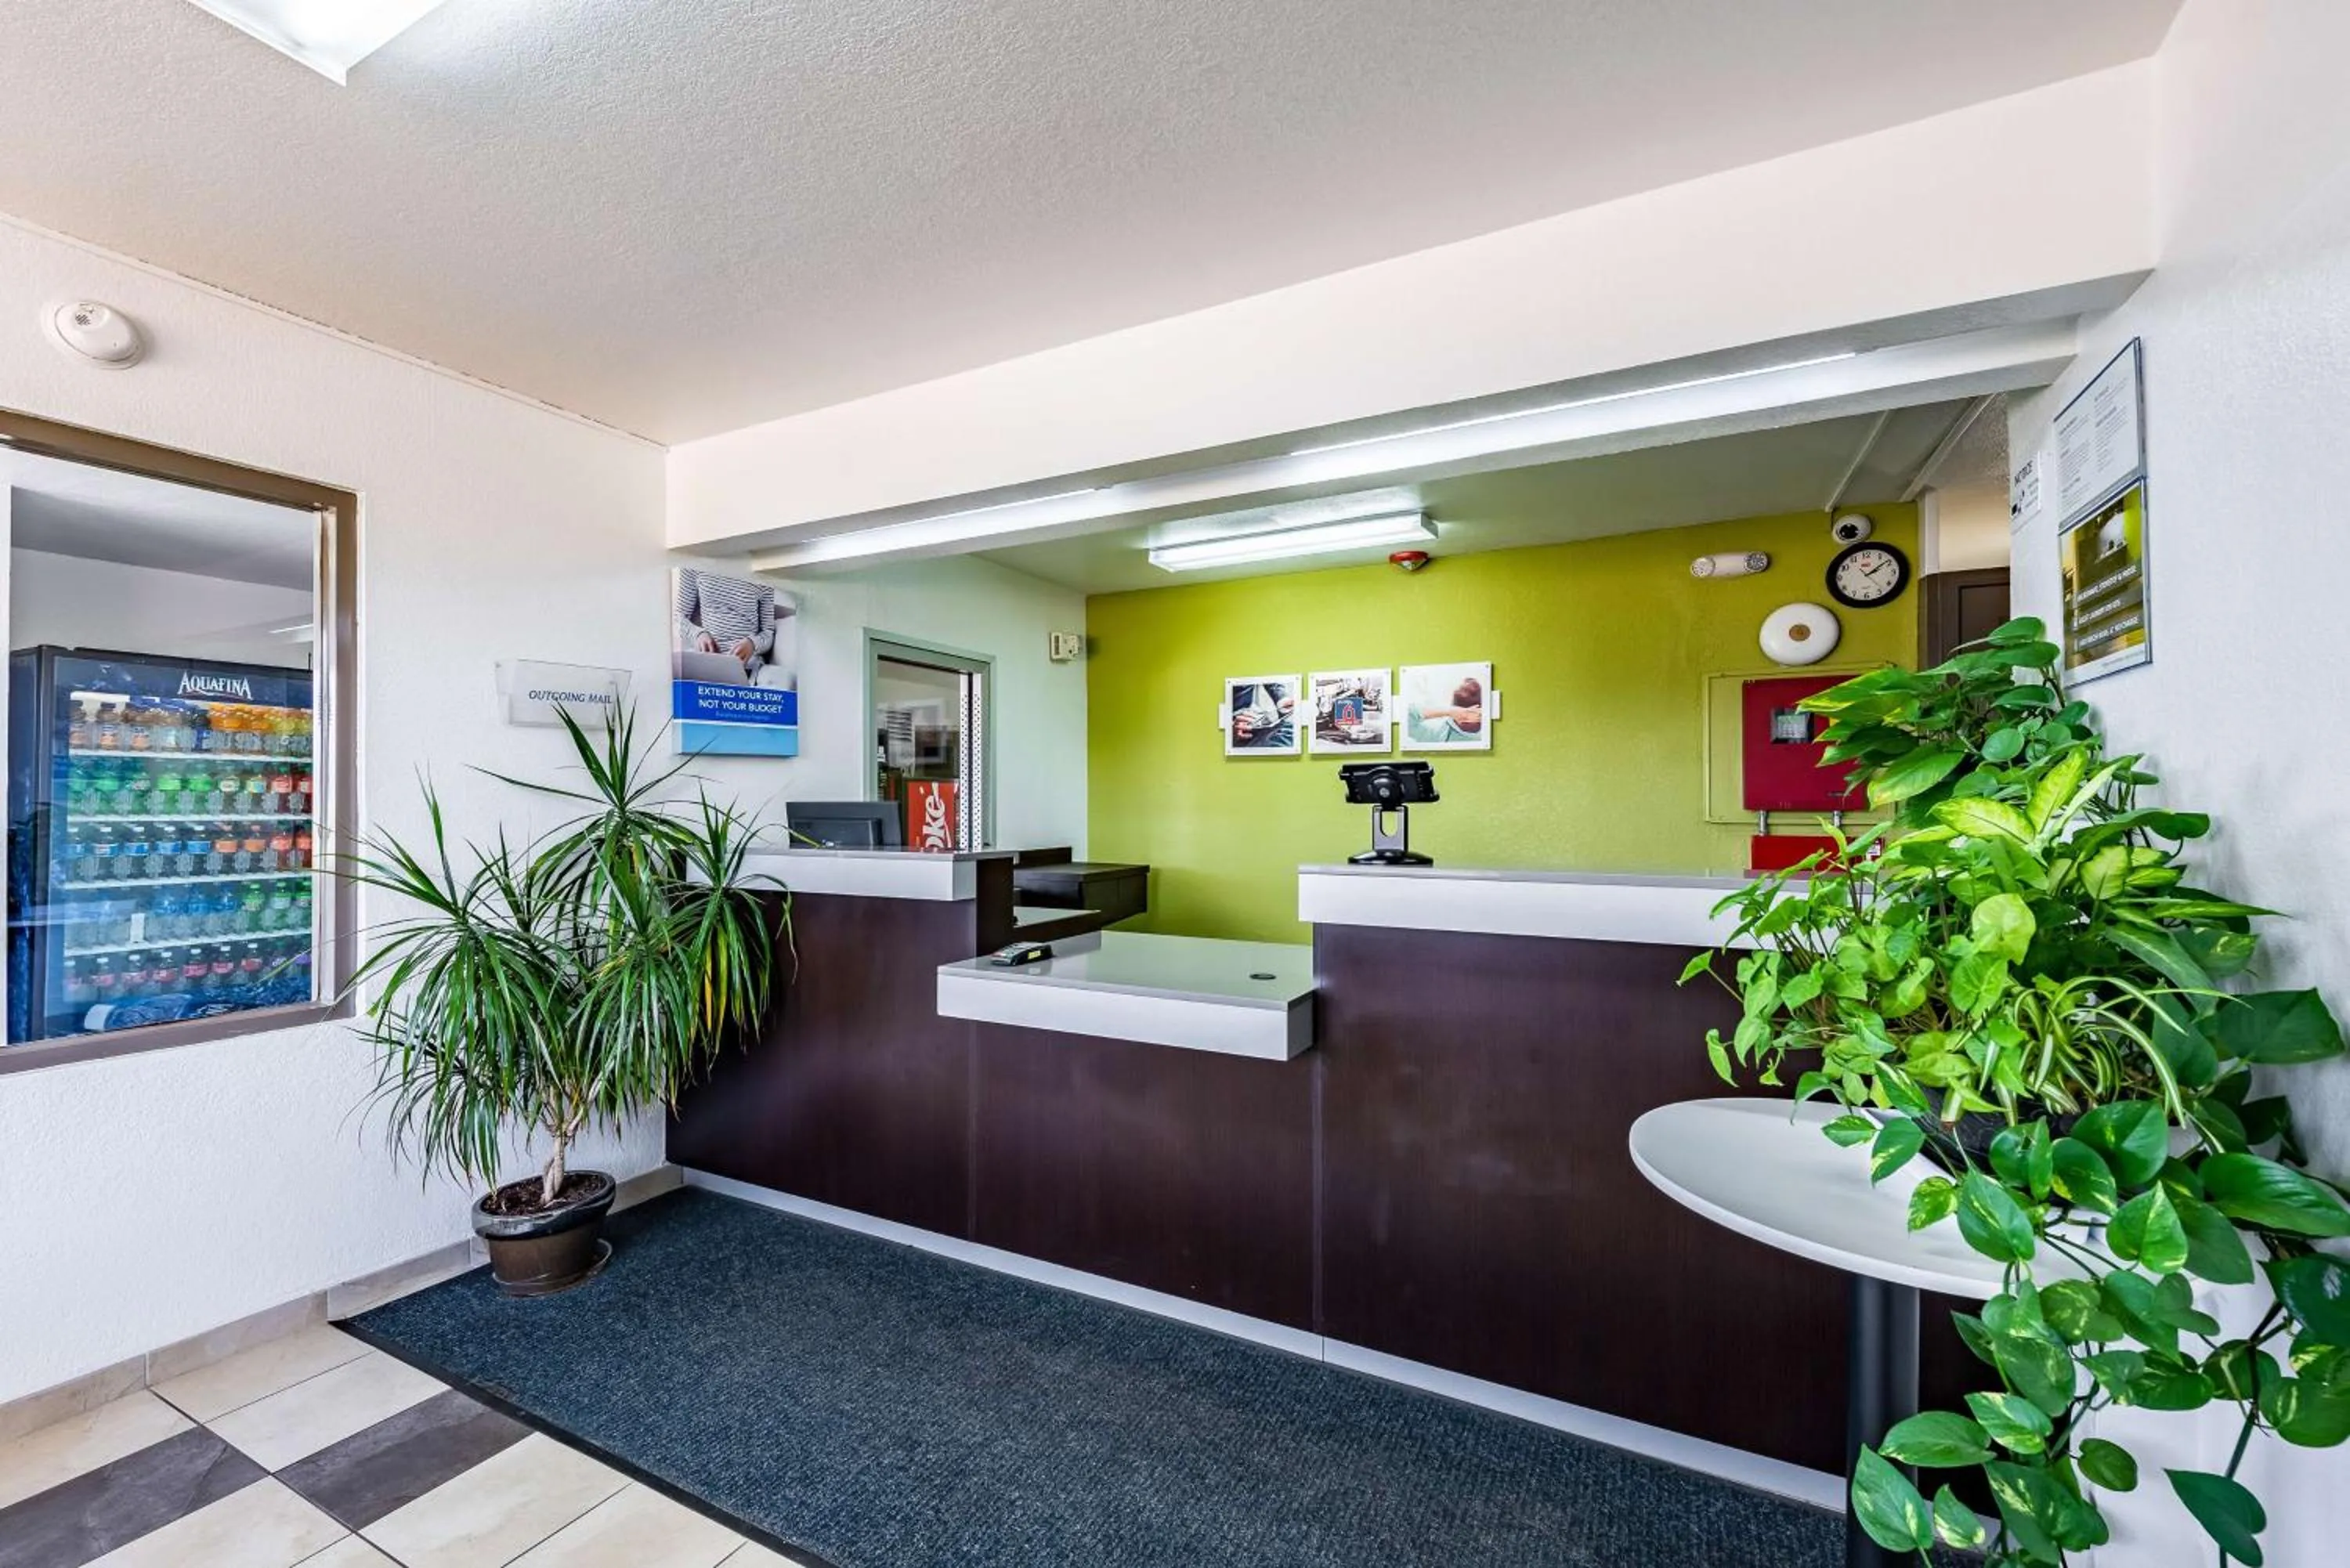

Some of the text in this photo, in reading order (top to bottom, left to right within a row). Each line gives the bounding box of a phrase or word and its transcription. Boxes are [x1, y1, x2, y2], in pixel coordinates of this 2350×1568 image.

[1862, 551, 1871, 559] 12
[177, 671, 254, 700] AQUAFINA
[698, 685, 736, 698] EXTEND
[737, 690, 761, 699] YOUR
[529, 690, 612, 704] OUTGOING MAIL
[699, 699, 783, 714] NOT YOUR BUDGET
[922, 782, 949, 849] oke
